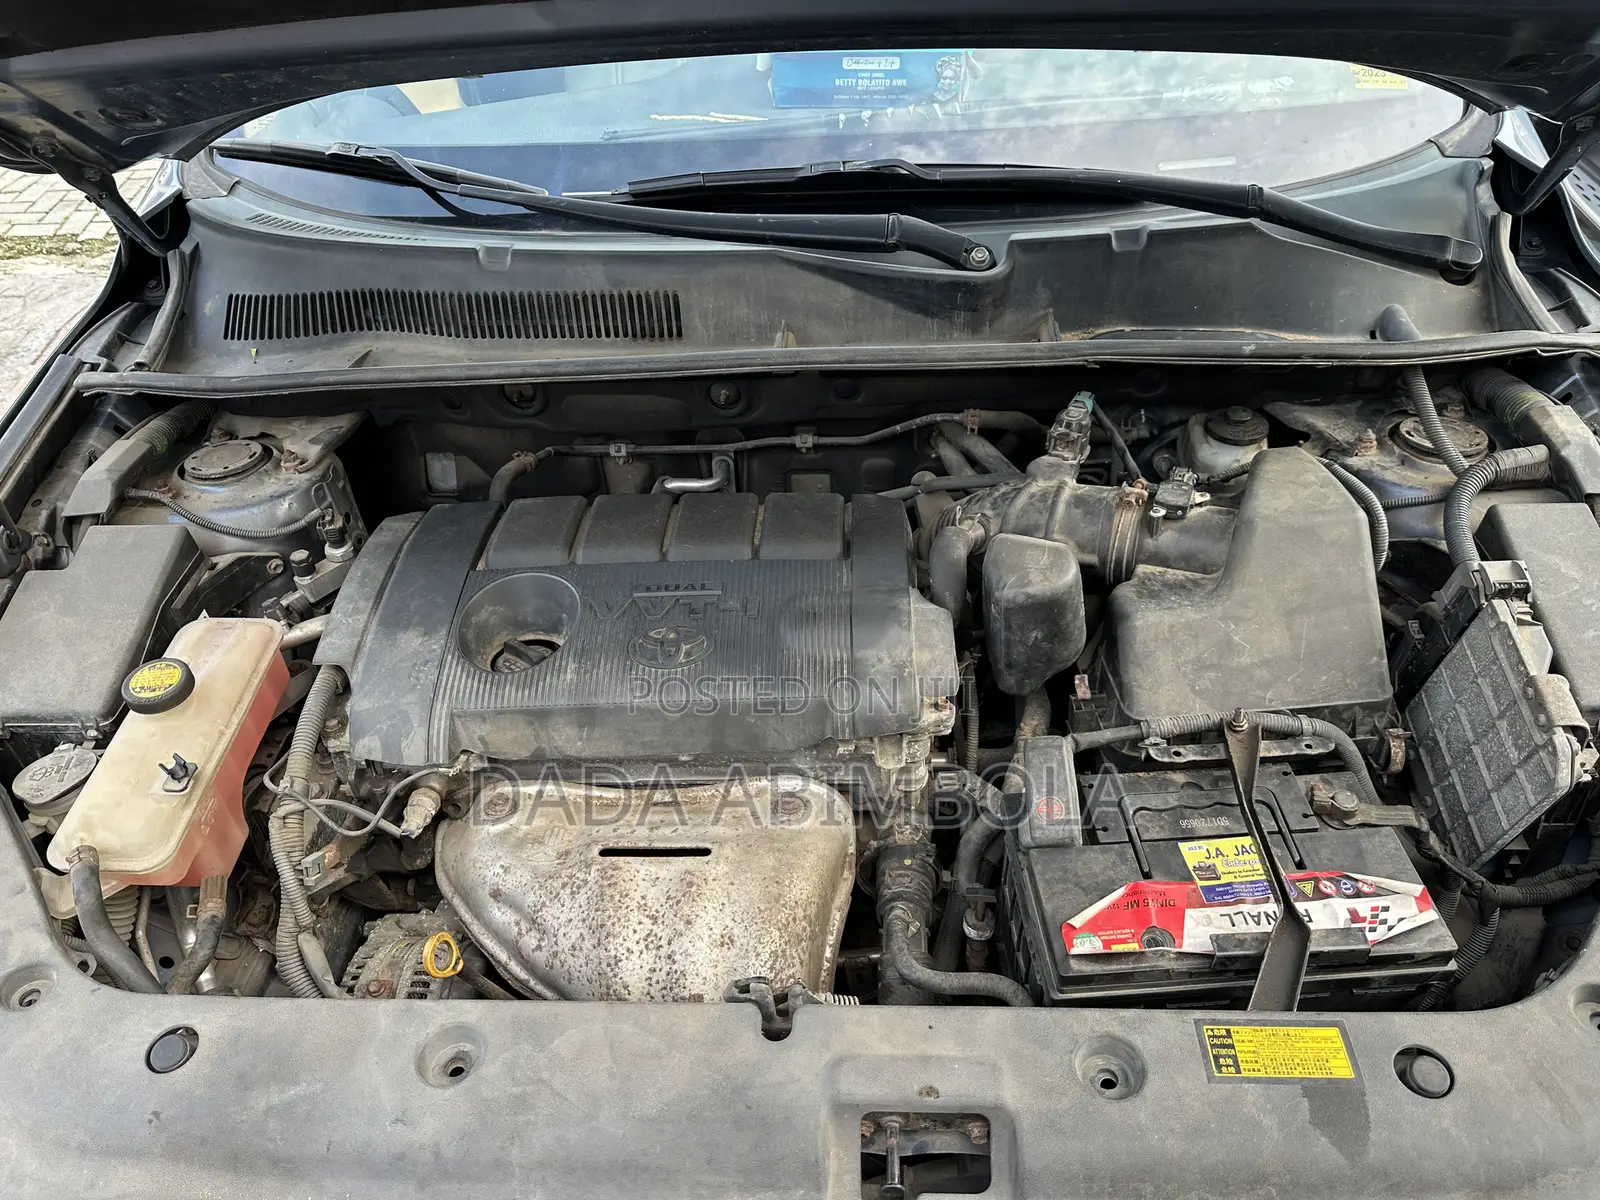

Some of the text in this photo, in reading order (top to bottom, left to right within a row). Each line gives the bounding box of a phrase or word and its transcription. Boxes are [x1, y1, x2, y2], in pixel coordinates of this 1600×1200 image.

[835, 78, 908, 87] BETTY BOLATITO AWE
[646, 582, 714, 592] DUAL
[1204, 846, 1230, 860] J.A.
[1123, 900, 1140, 911] MF
[1209, 1037, 1233, 1045] CAUTION
